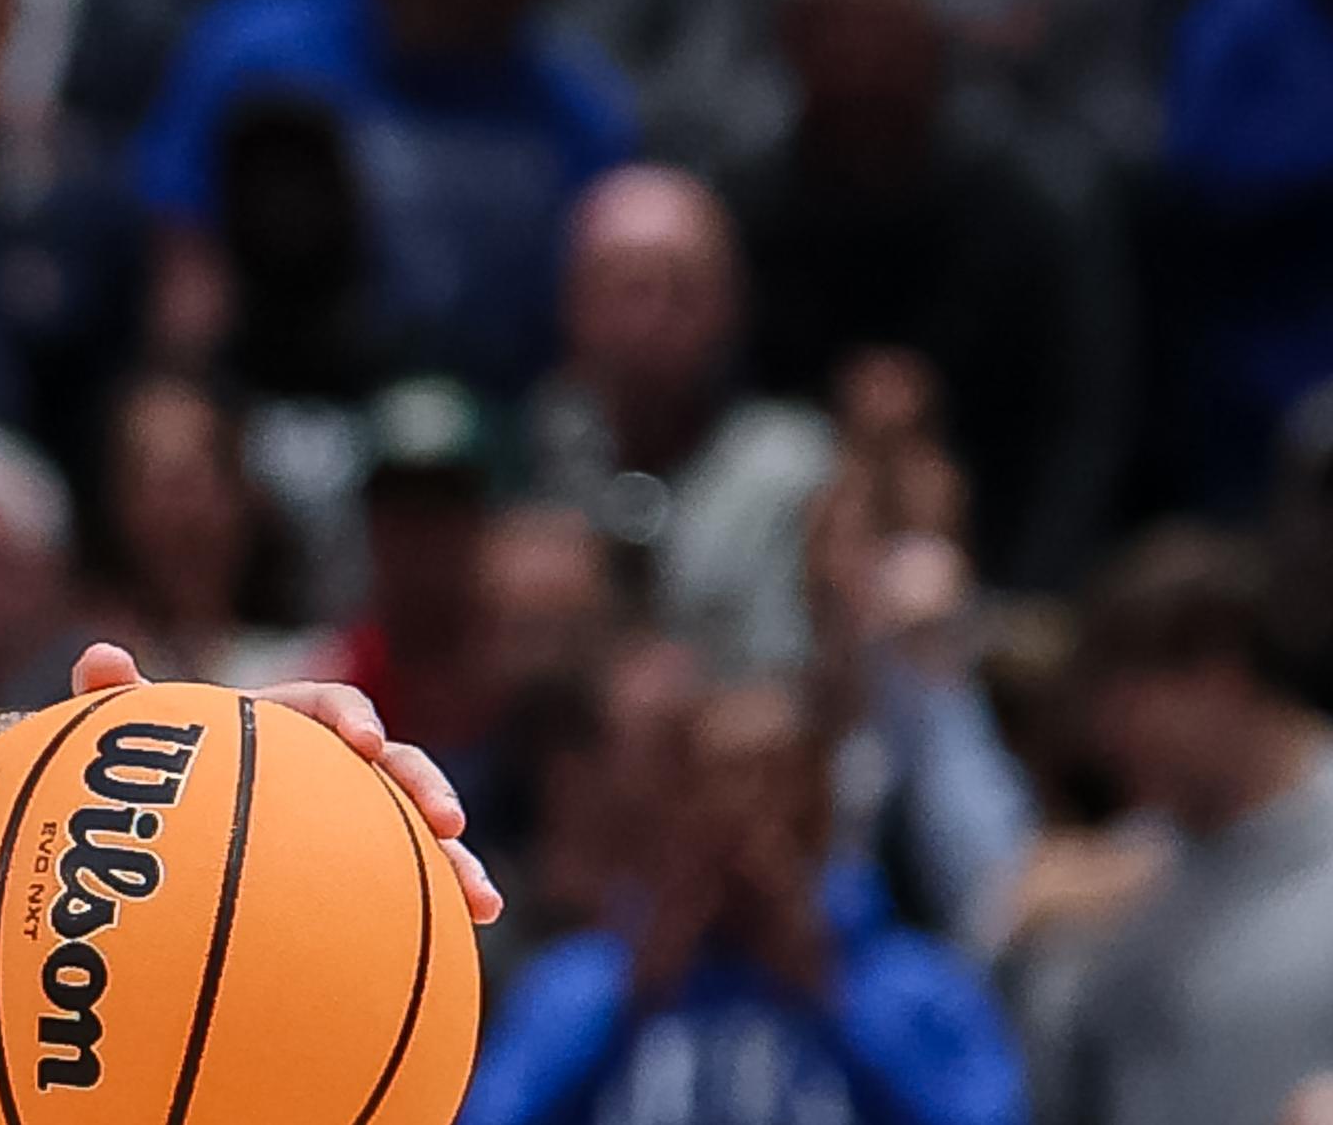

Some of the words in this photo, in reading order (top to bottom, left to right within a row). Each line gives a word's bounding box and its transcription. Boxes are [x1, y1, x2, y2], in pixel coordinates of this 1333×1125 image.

[33, 821, 58, 874] EVO
[22, 883, 46, 942] NXT
[35, 721, 208, 1093] Wilson
